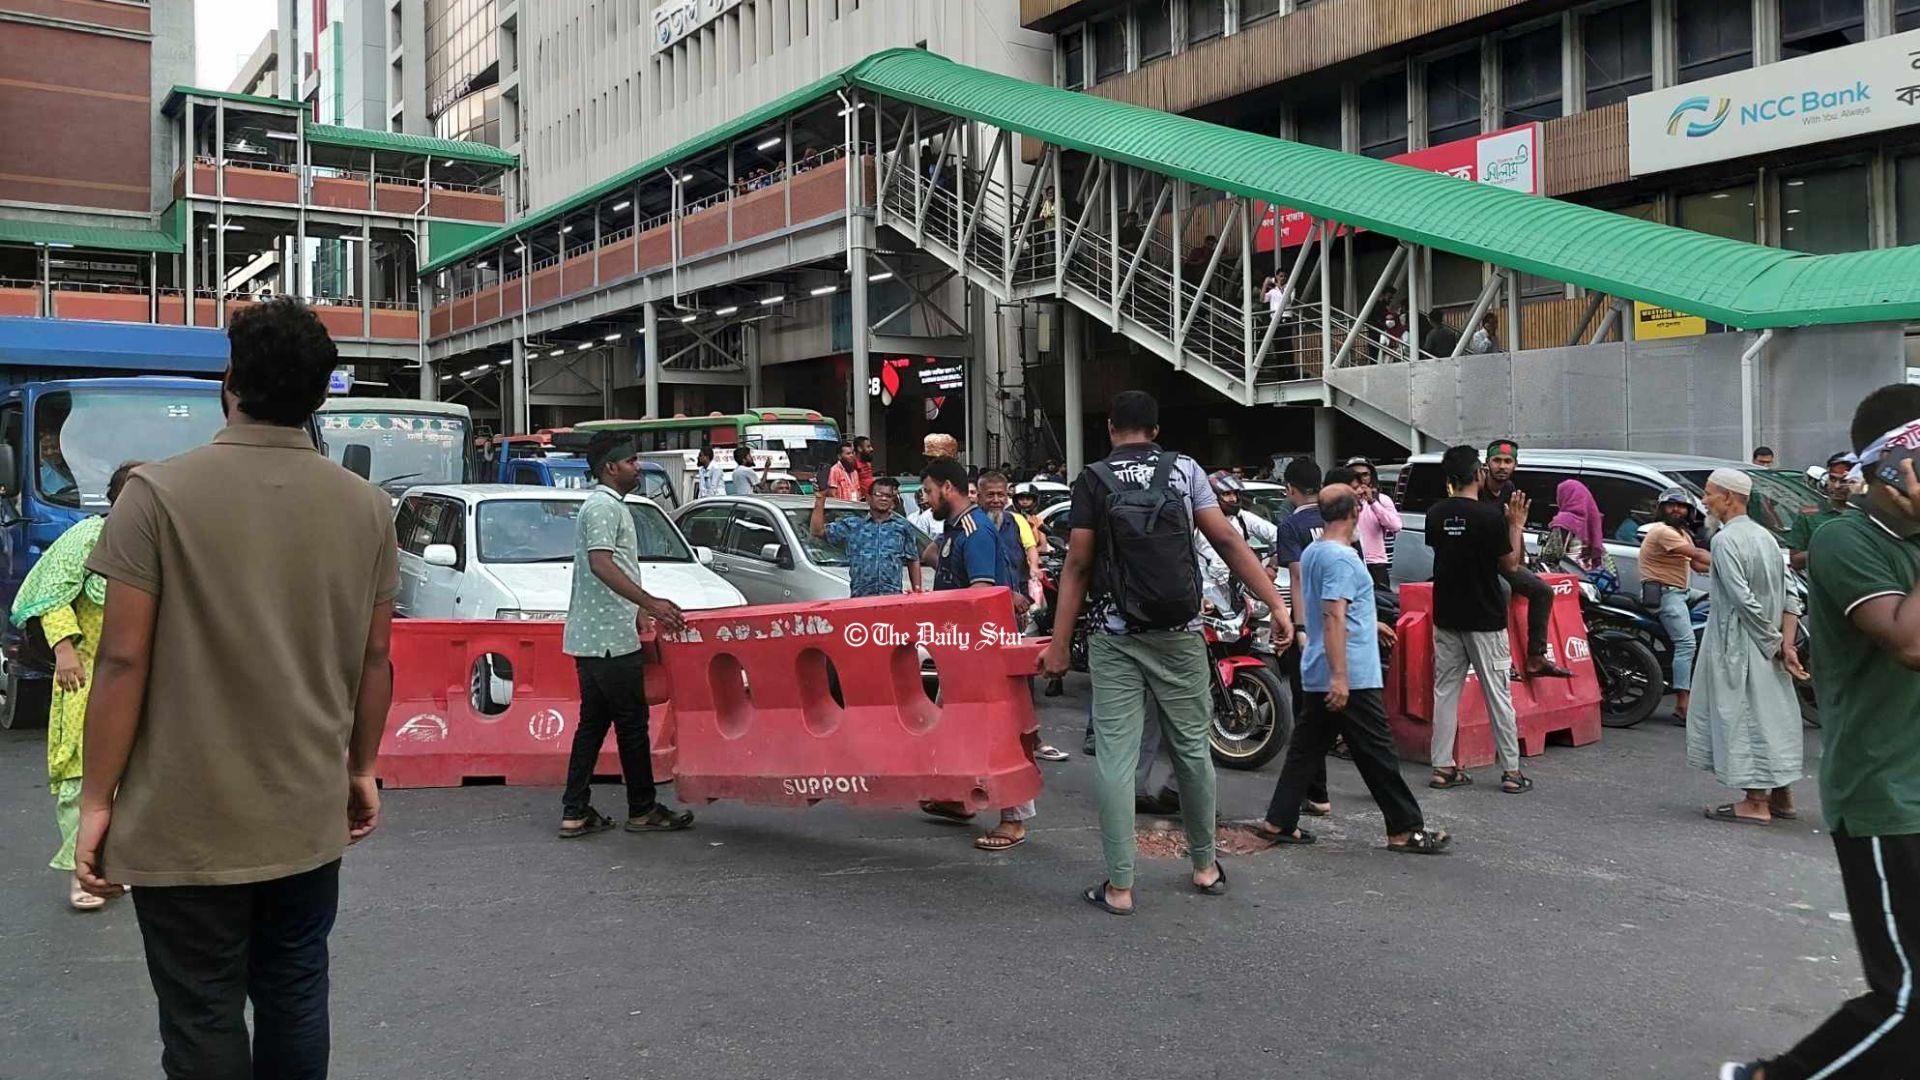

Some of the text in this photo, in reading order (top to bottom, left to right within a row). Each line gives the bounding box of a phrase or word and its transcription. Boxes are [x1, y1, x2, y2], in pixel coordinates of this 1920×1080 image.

[1741, 96, 1795, 125] NCC
[1801, 81, 1871, 112] Bank
[1802, 112, 1821, 126] With
[1841, 106, 1871, 118] Always
